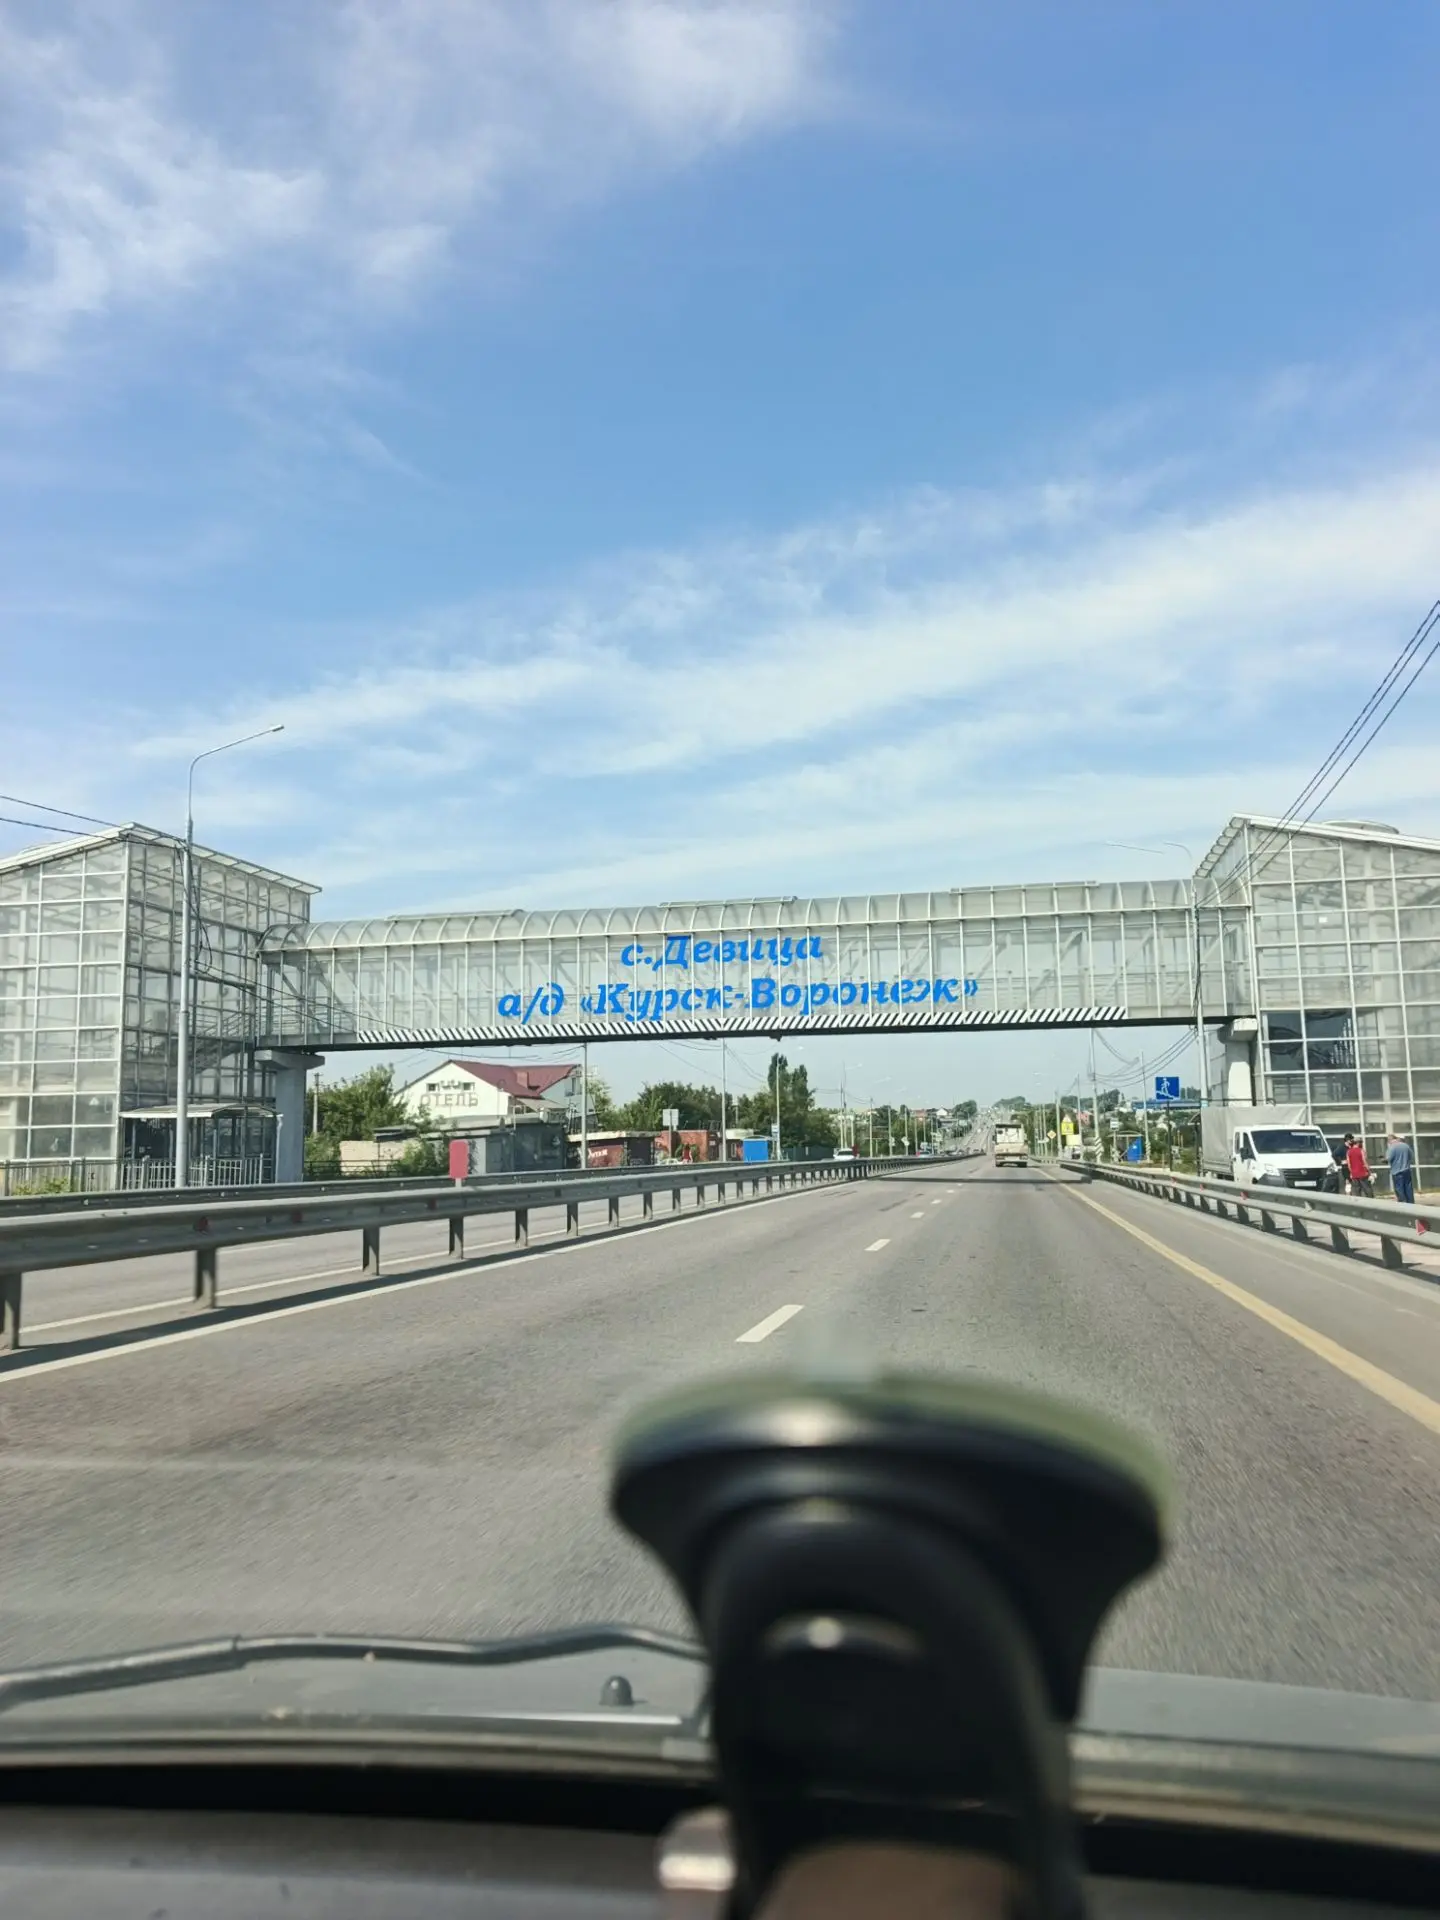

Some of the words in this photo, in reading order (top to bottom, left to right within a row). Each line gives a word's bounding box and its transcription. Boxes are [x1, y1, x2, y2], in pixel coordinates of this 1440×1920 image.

[620, 934, 824, 972] с.Девица
[497, 982, 566, 1025] а/д
[580, 976, 979, 1024] «Курск-Воронеж»
[420, 1093, 479, 1107] ОТЕЛЬ
